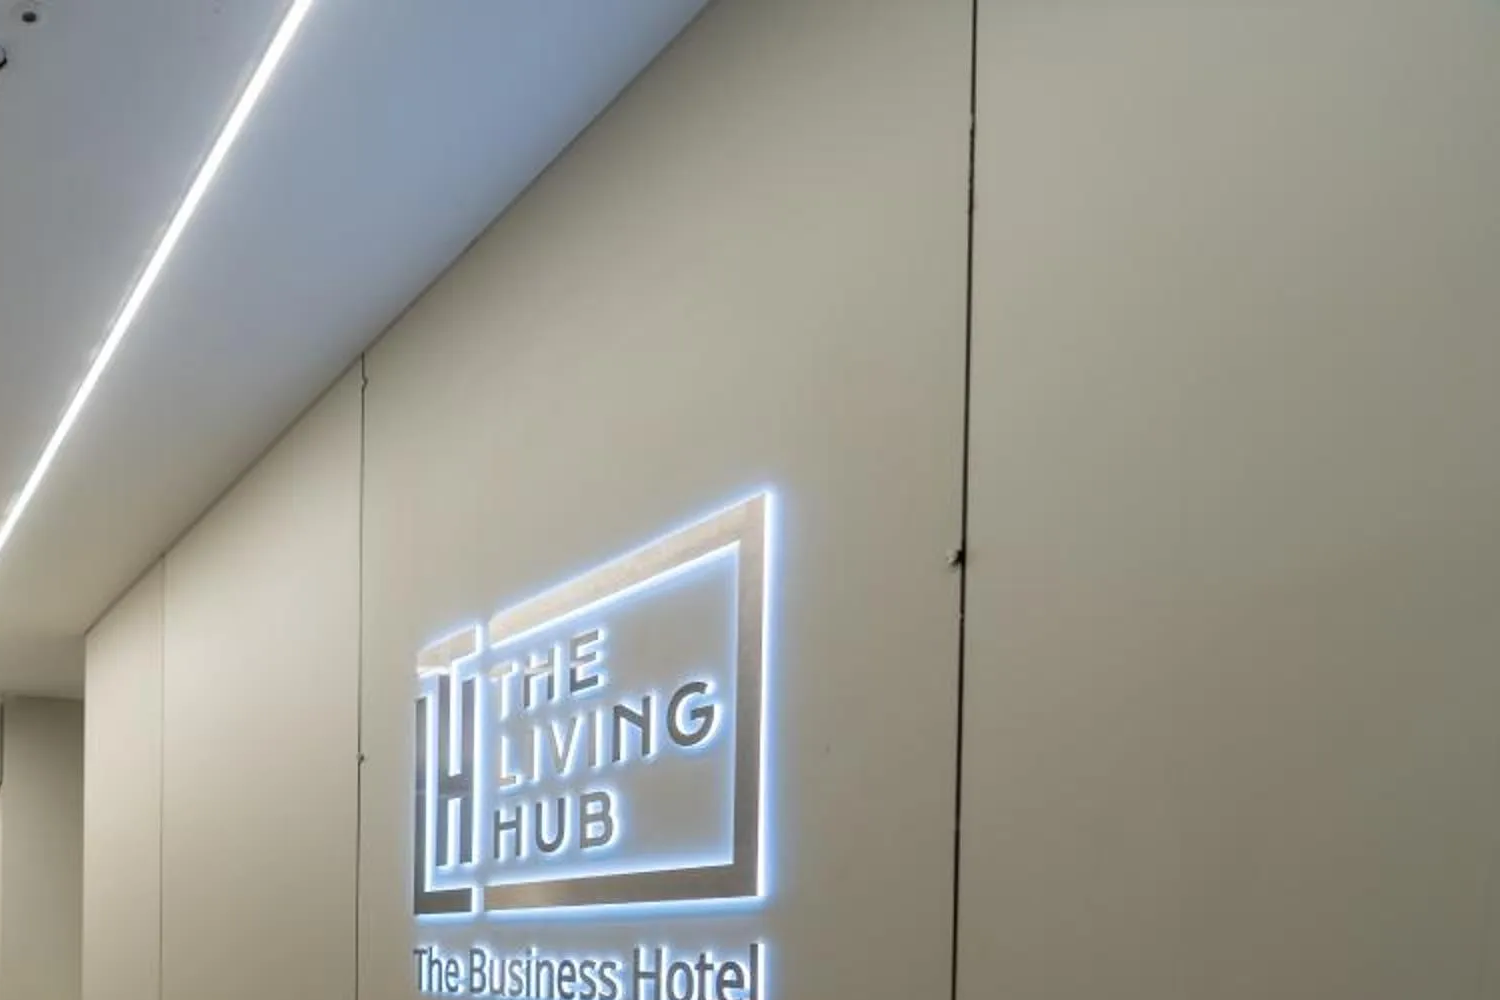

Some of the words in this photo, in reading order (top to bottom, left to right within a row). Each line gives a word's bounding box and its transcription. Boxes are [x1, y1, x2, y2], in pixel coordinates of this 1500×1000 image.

[489, 628, 604, 721] THE
[500, 681, 717, 789] LIVING
[494, 790, 617, 860] HUB
[412, 945, 463, 994] The
